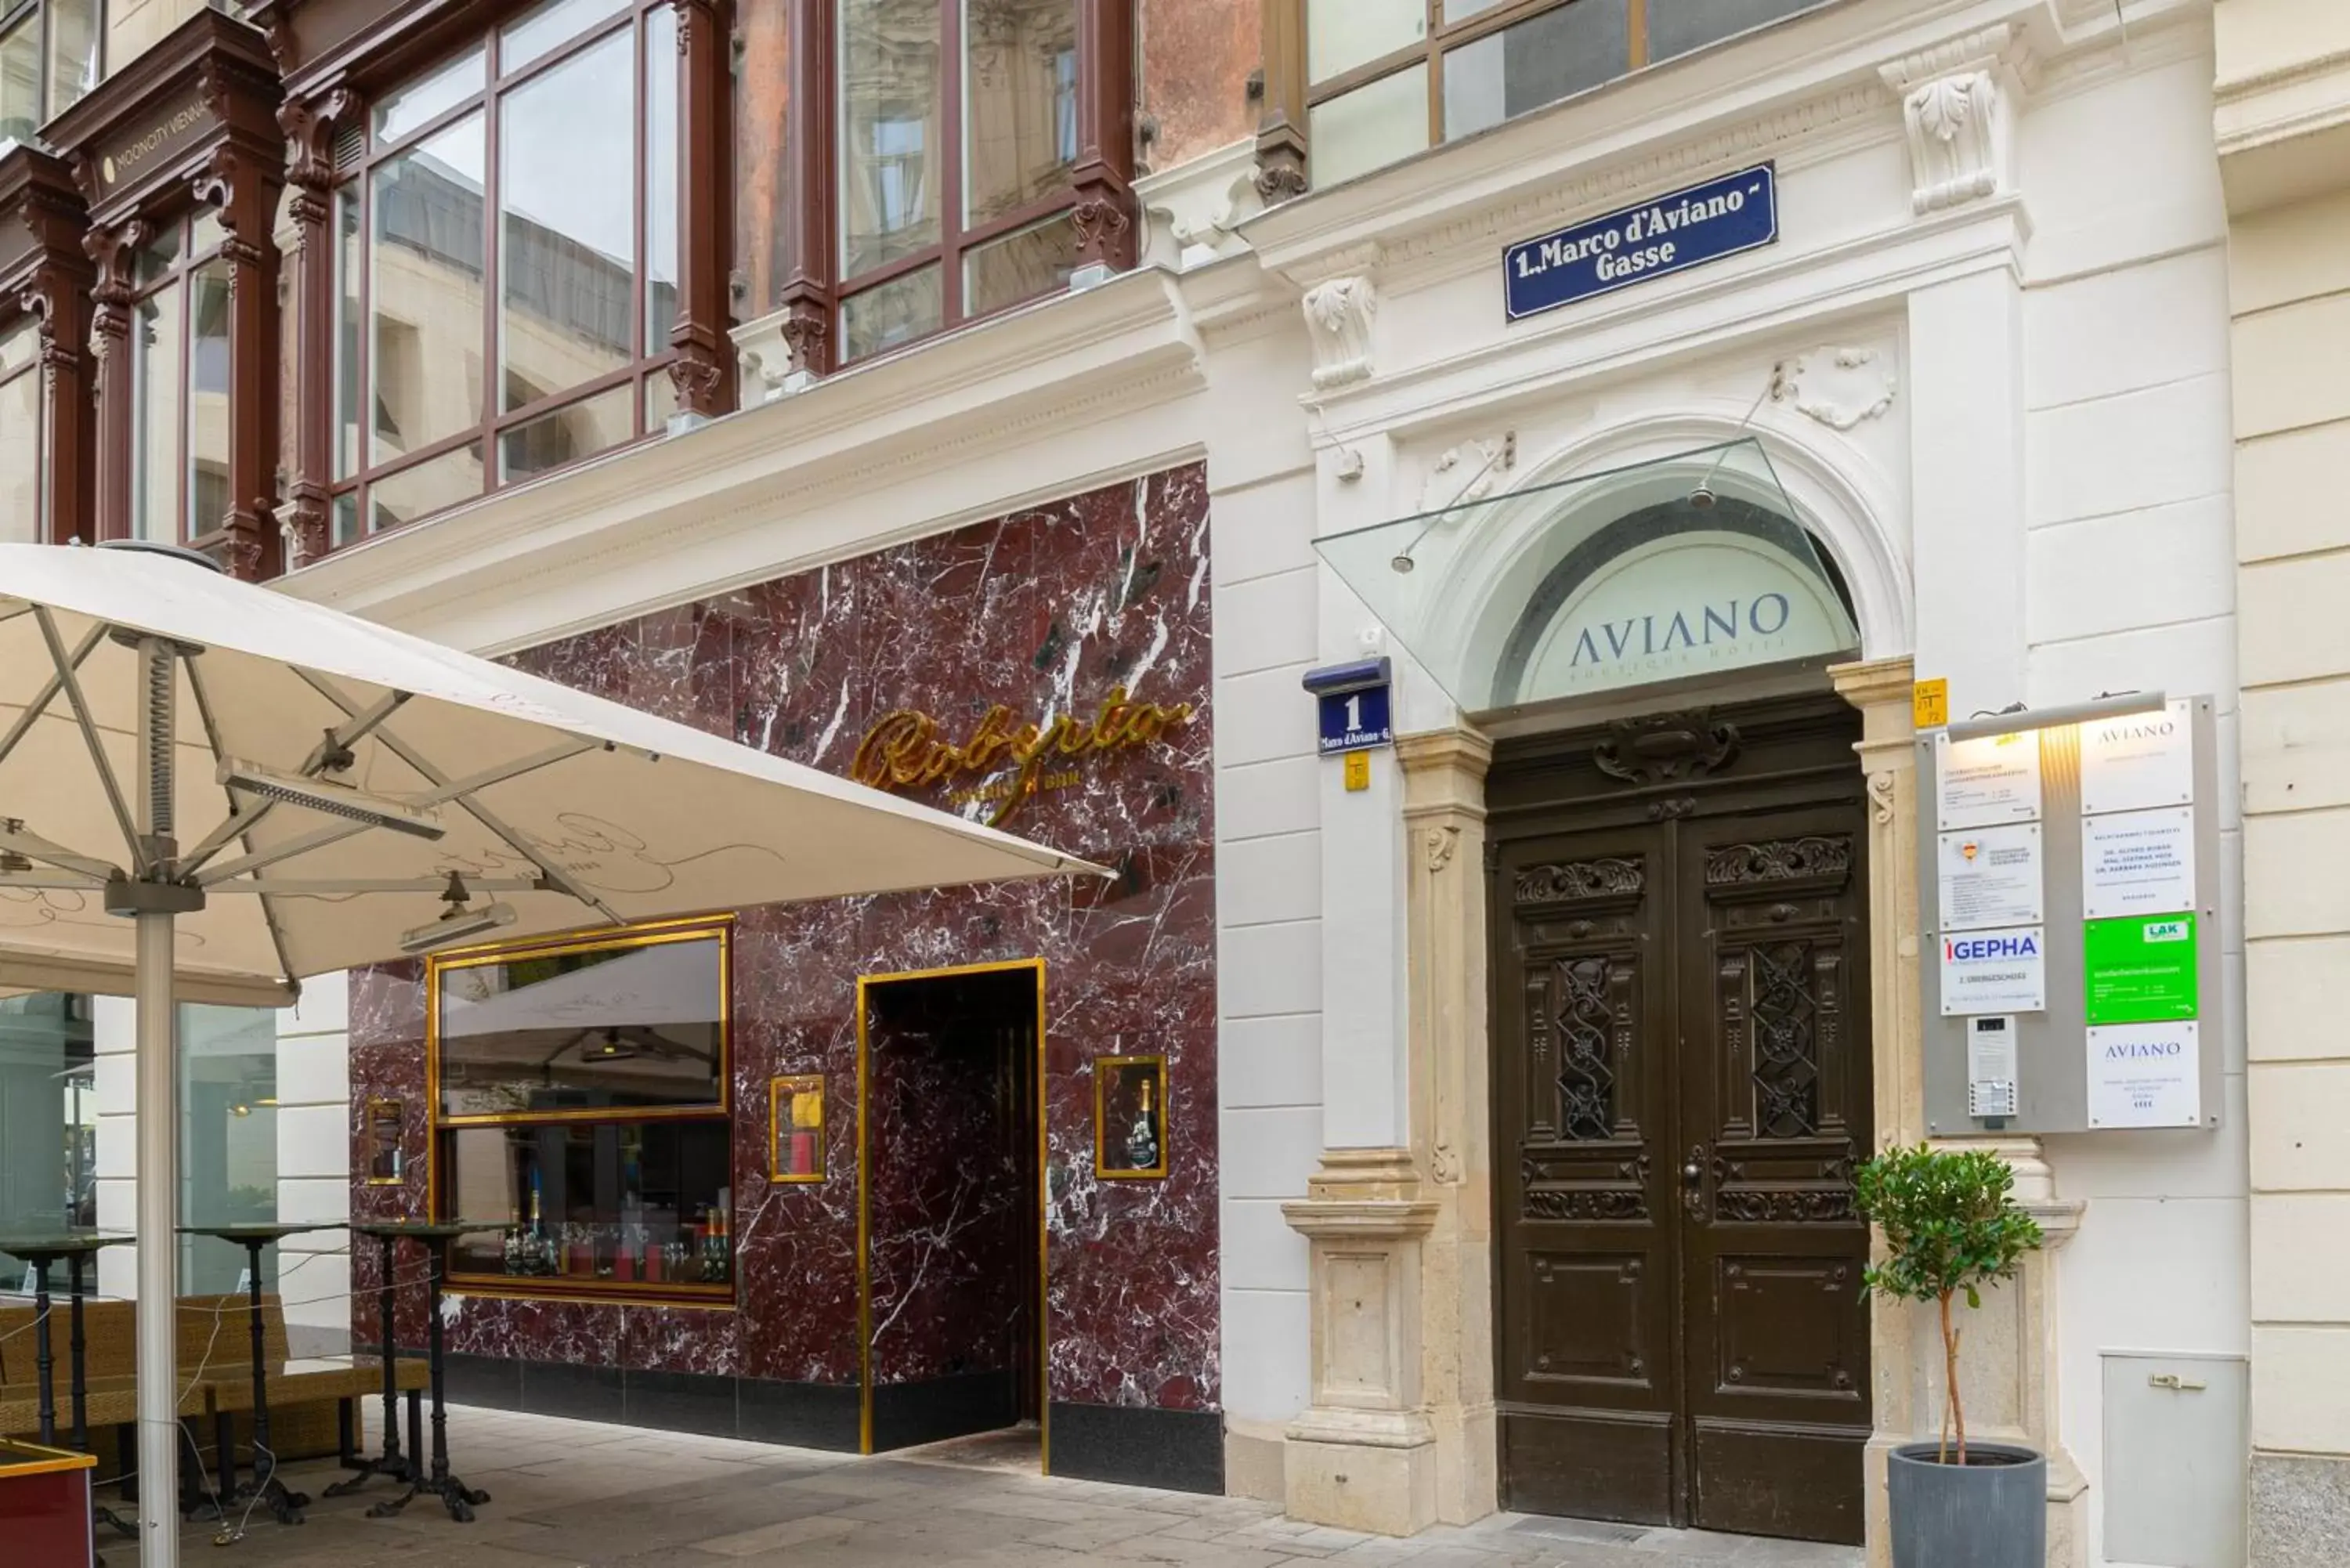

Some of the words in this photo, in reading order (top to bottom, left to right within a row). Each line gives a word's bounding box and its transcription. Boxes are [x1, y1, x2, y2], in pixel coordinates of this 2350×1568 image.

[118, 125, 168, 171] MOONCITY
[1596, 241, 1676, 282] Gasse
[1569, 593, 1789, 667] AVIANO
[1344, 694, 1362, 732] 1
[2099, 722, 2174, 745] AVIANO
[2149, 924, 2178, 935] LAK
[1947, 937, 2037, 960] IGEPHA
[2105, 1042, 2181, 1059] AVIANO
